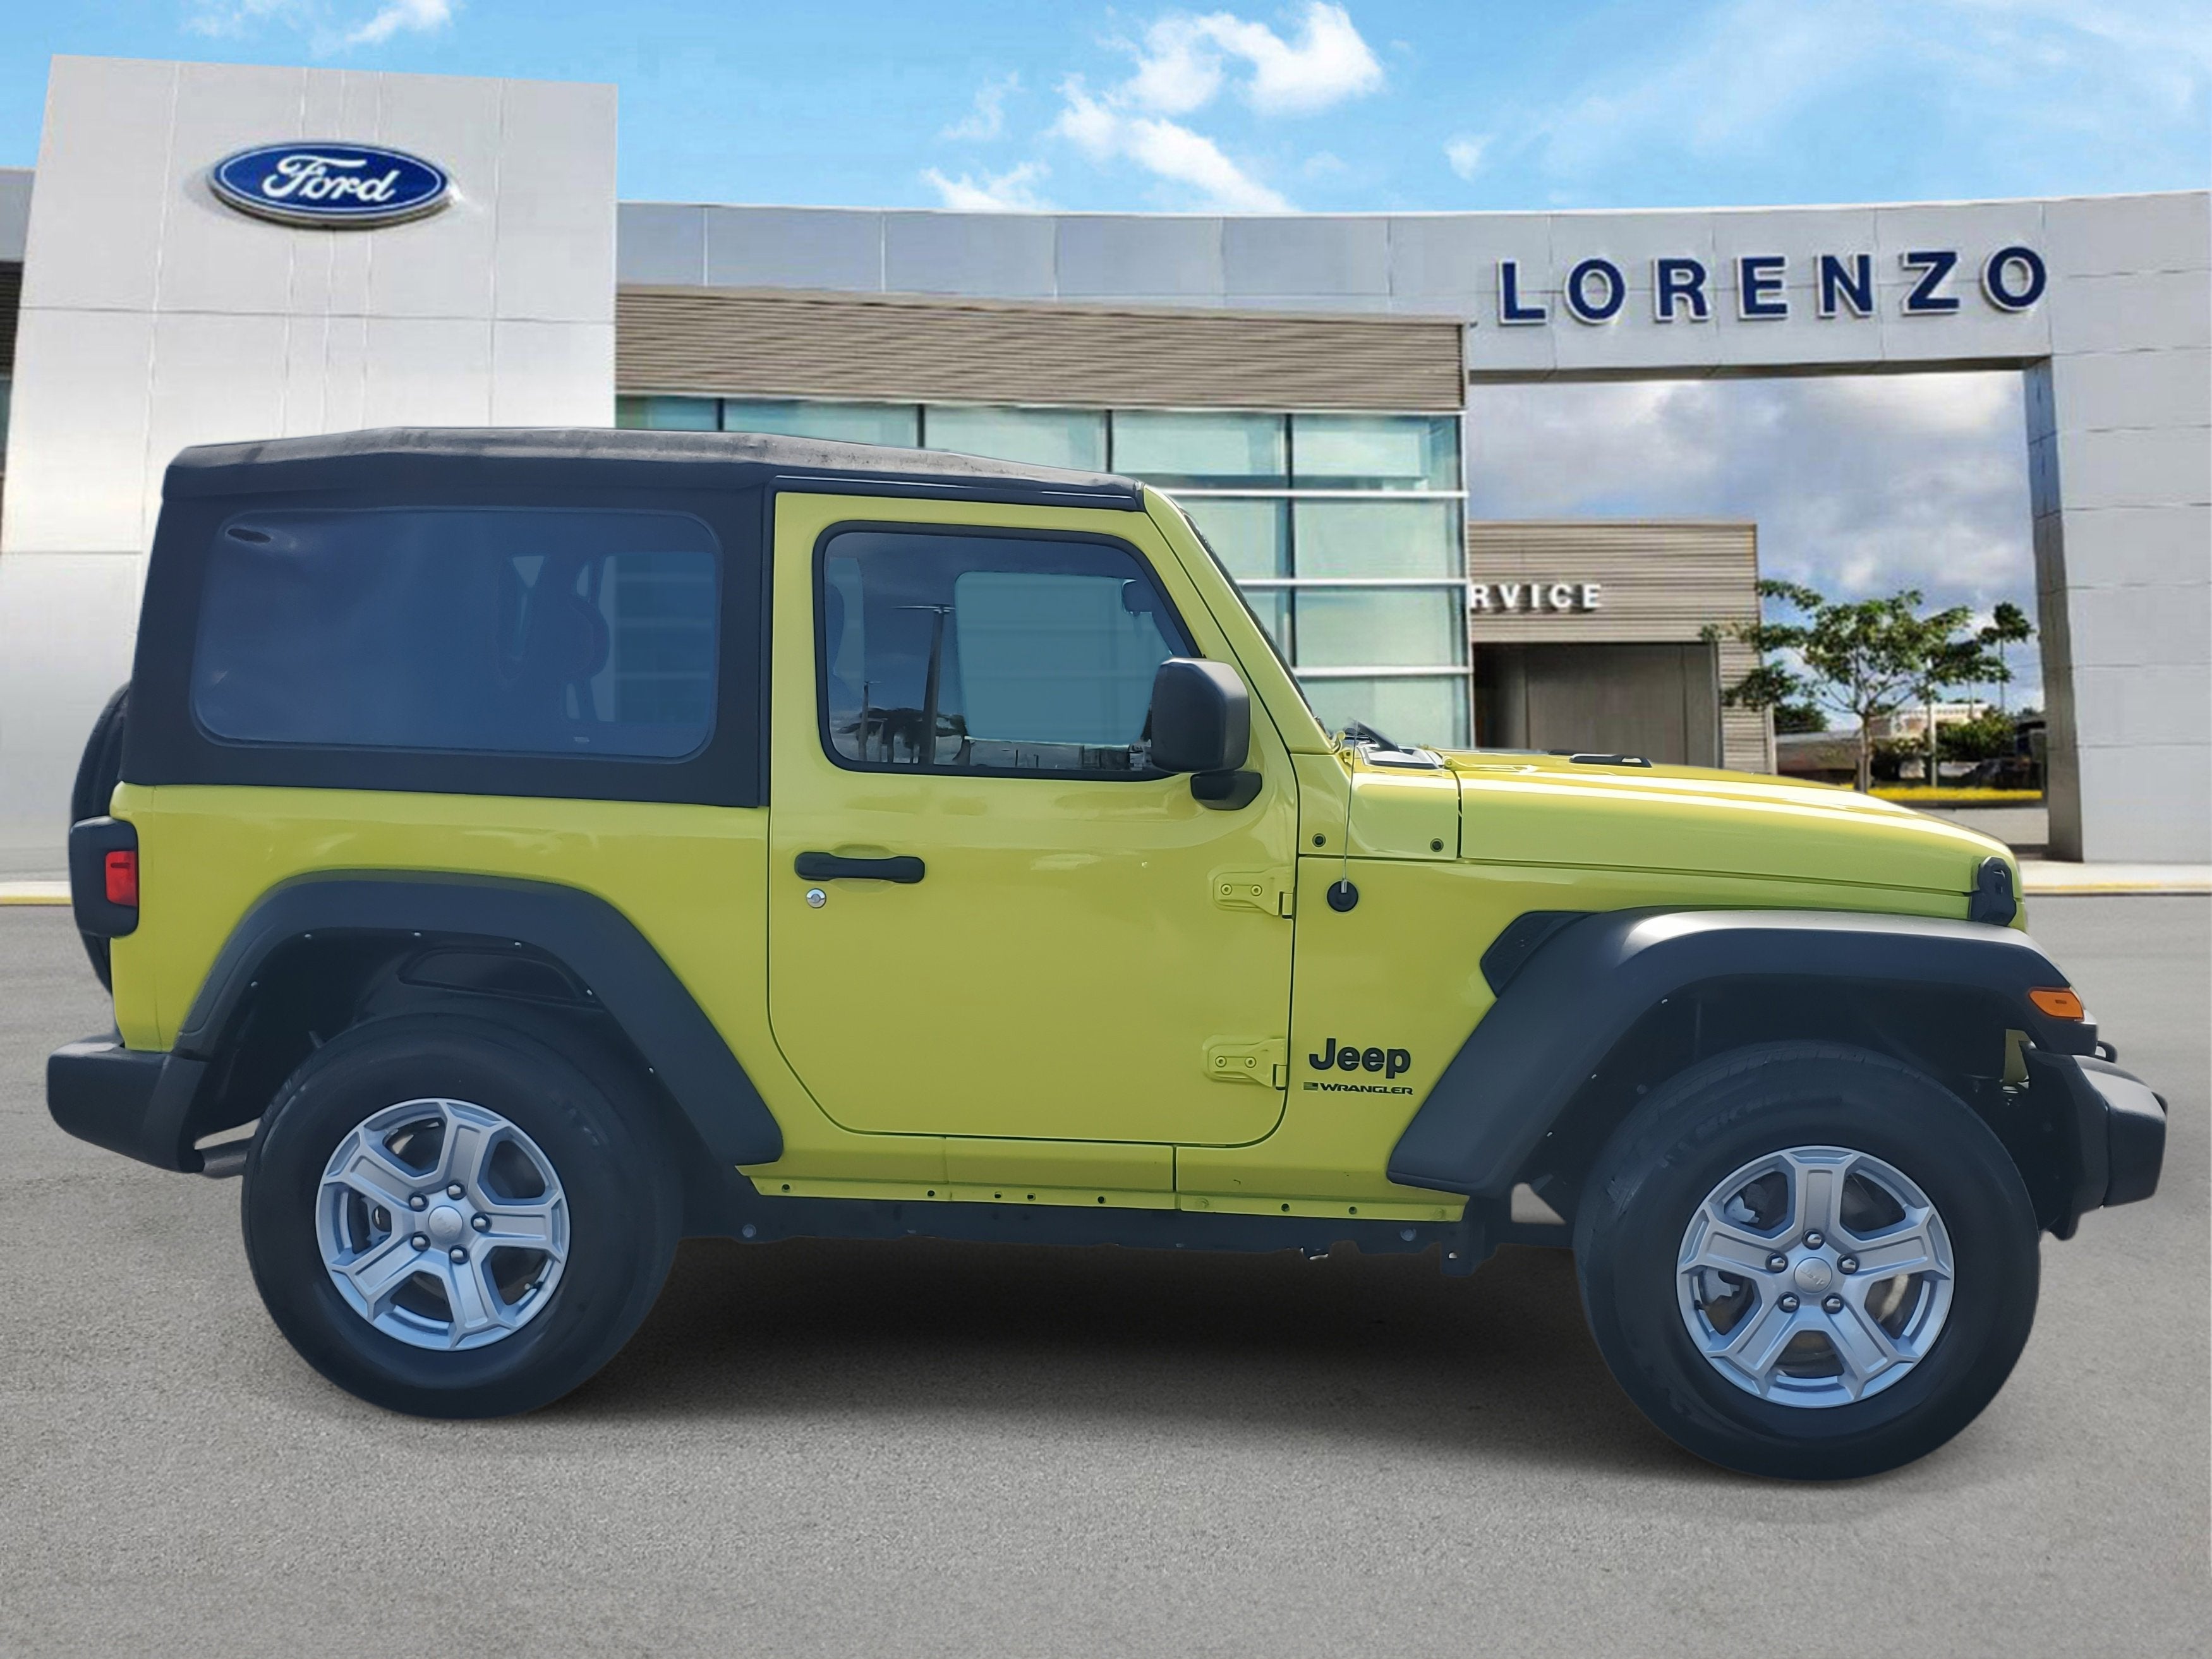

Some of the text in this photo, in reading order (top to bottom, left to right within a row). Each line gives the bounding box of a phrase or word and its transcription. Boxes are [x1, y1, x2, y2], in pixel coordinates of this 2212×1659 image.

[262, 154, 401, 202] Ford
[1498, 246, 2047, 325] LORENZO
[1308, 1037, 1411, 1079] Jeep
[1319, 1082, 1413, 1095] WRANGLER
